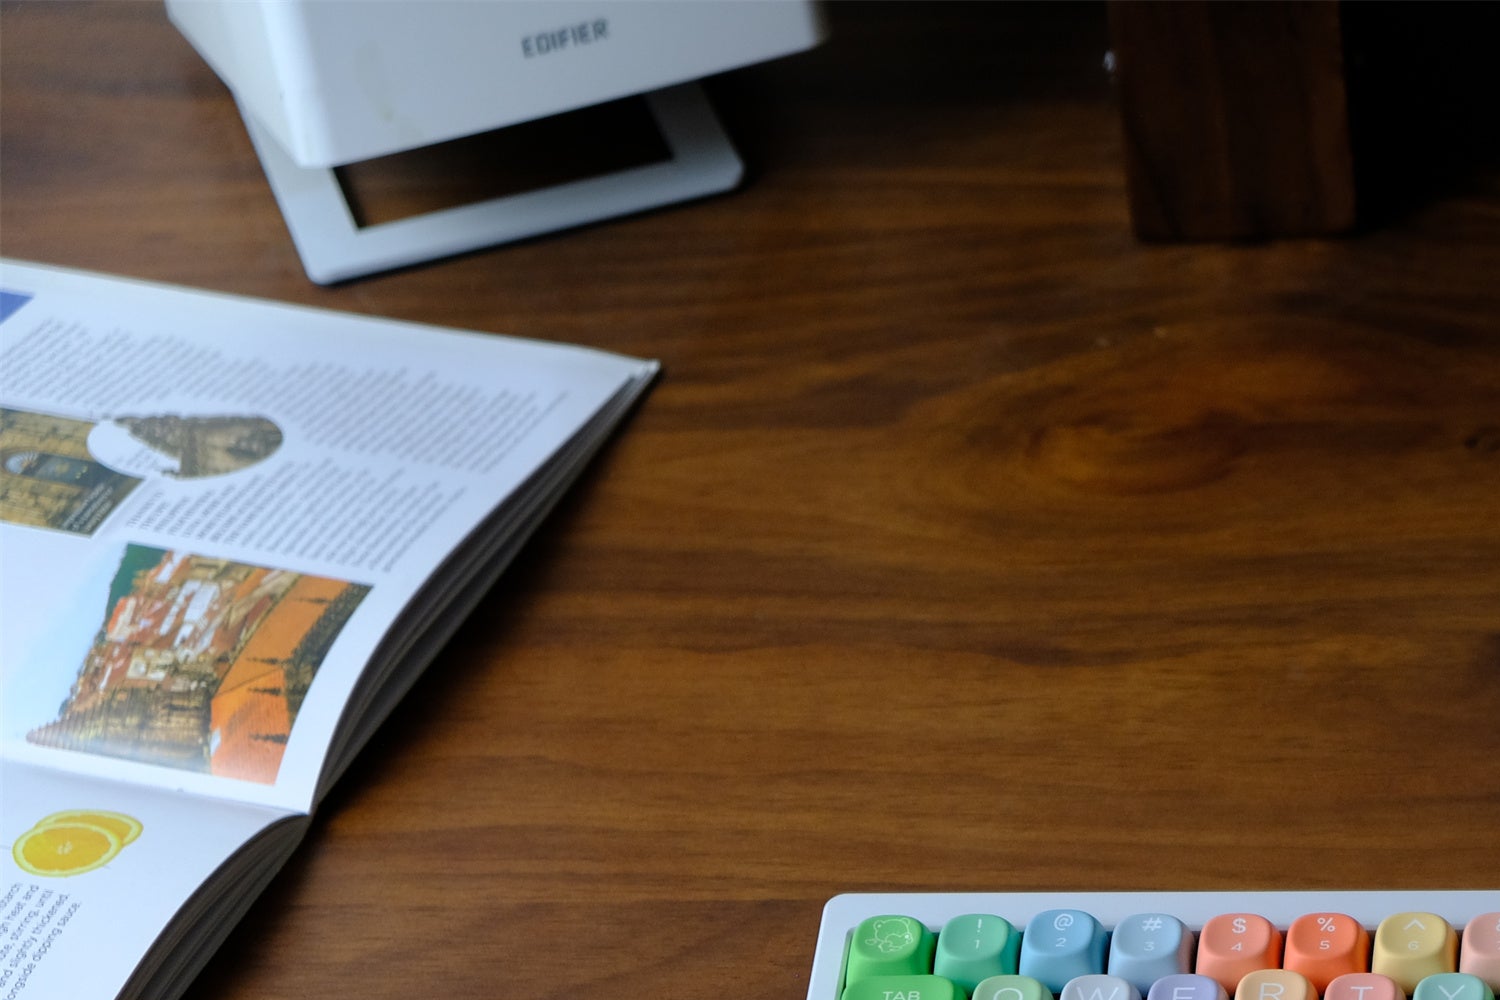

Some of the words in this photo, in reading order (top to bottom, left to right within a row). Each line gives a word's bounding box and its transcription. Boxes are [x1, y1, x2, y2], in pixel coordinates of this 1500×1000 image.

[521, 19, 609, 58] EDIFIER
[976, 918, 983, 934] !
[1053, 913, 1074, 932] @
[1142, 917, 1163, 932] #
[1232, 917, 1247, 934] $
[1317, 917, 1336, 933] %
[1403, 918, 1426, 931] ^
[32, 927, 63, 962] dipping
[1055, 937, 1067, 948] 2
[1143, 941, 1155, 951] 3
[1231, 942, 1242, 951] 4
[1319, 940, 1330, 950] 5
[1408, 940, 1420, 950] 6
